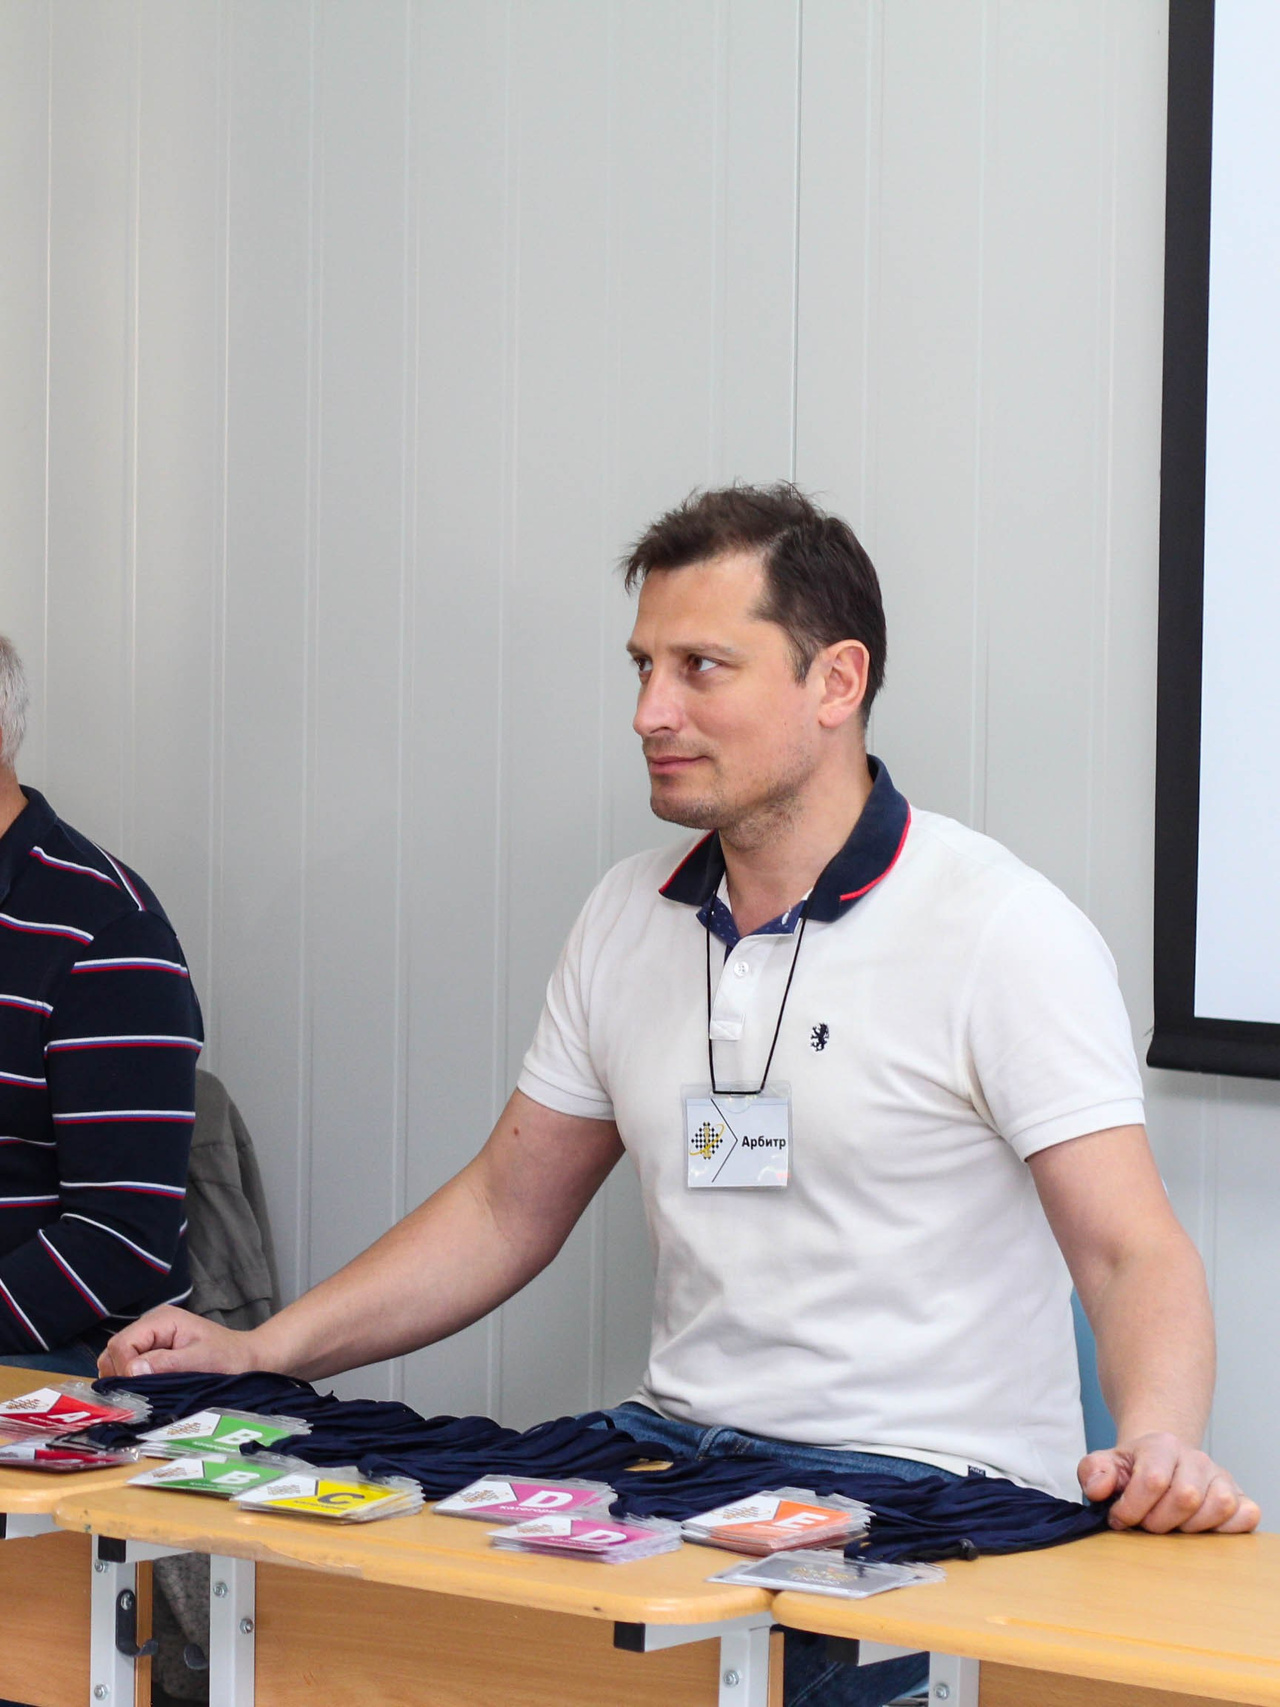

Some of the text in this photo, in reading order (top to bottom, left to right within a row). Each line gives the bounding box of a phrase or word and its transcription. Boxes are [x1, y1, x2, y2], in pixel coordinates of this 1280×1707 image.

[741, 1135, 786, 1149] Арбитр
[47, 1410, 92, 1423] A
[214, 1428, 263, 1445] B
[210, 1470, 261, 1484] B
[317, 1492, 366, 1505] C
[518, 1490, 574, 1507] D
[771, 1511, 829, 1529] E
[570, 1529, 628, 1544] D
